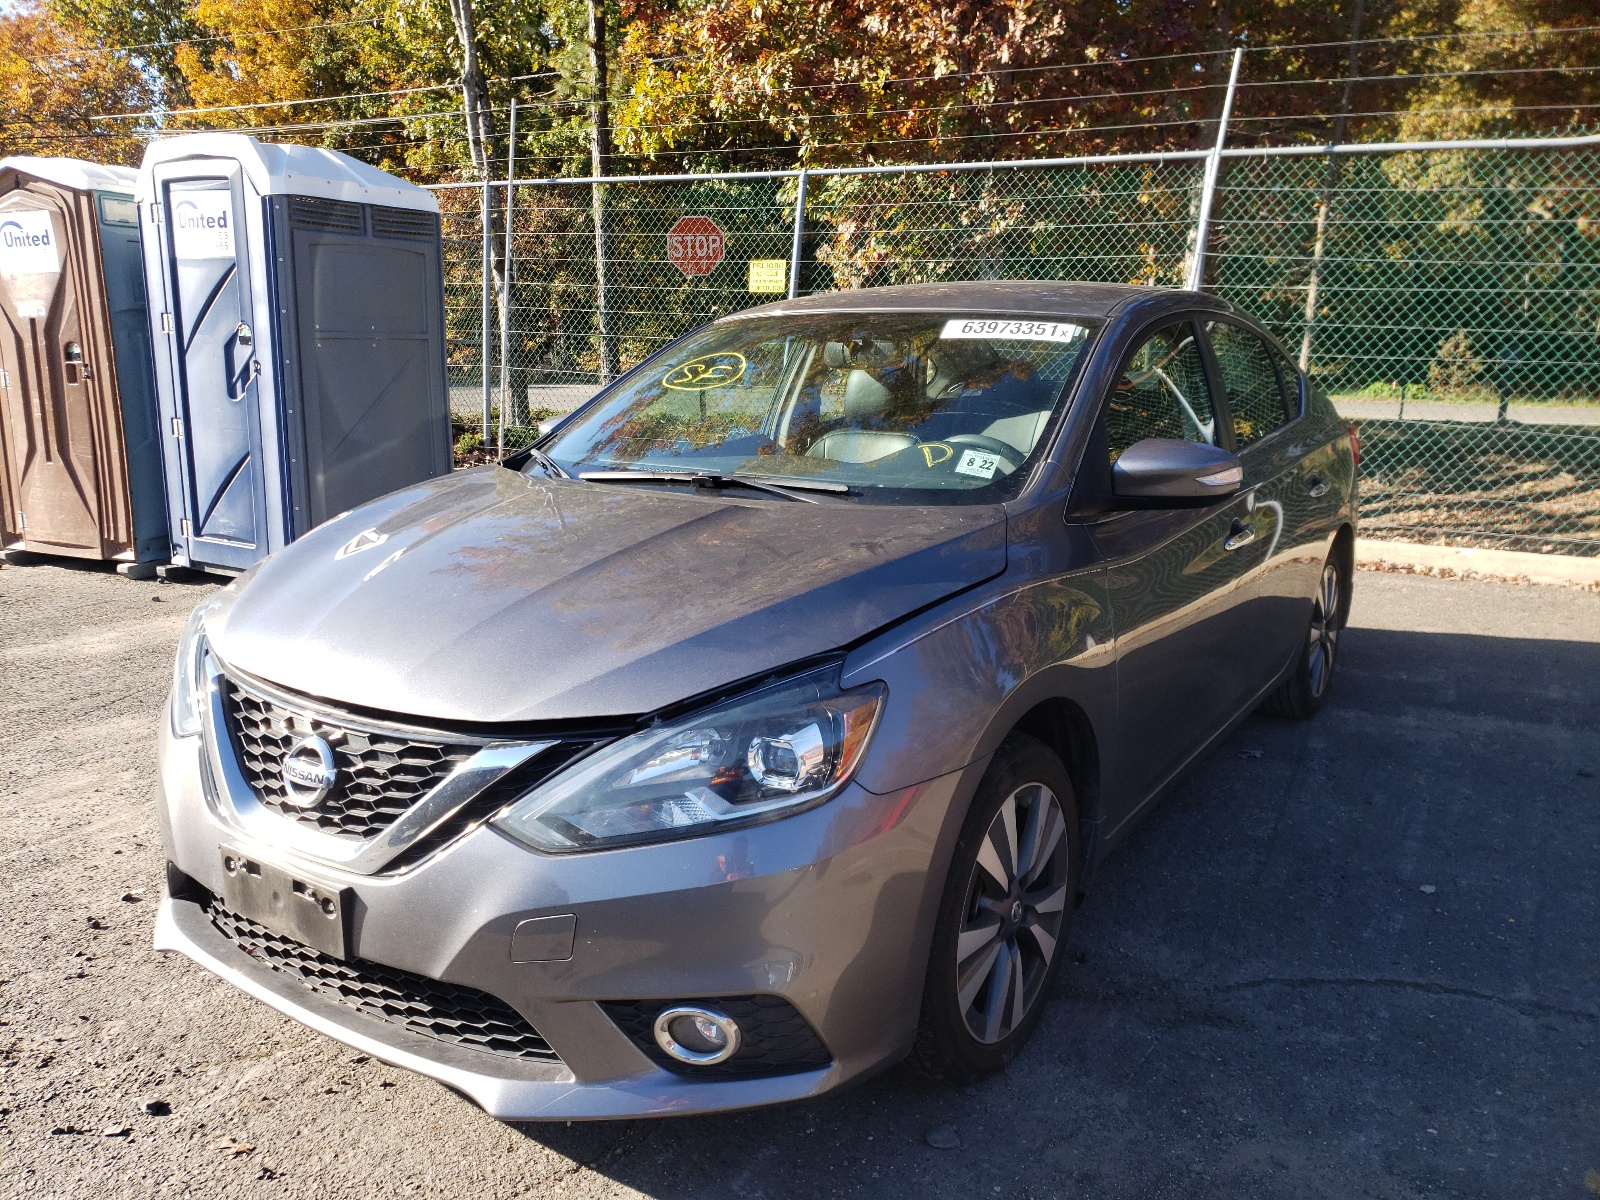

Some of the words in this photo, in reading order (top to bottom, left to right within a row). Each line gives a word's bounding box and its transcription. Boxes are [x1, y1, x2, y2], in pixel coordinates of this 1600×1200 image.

[179, 210, 228, 229] United
[4, 229, 51, 248] United
[672, 235, 721, 257] STOP
[961, 321, 1059, 337] 63973351
[966, 457, 976, 467] 8
[979, 459, 995, 470] 22
[283, 763, 326, 784] NISSAN
